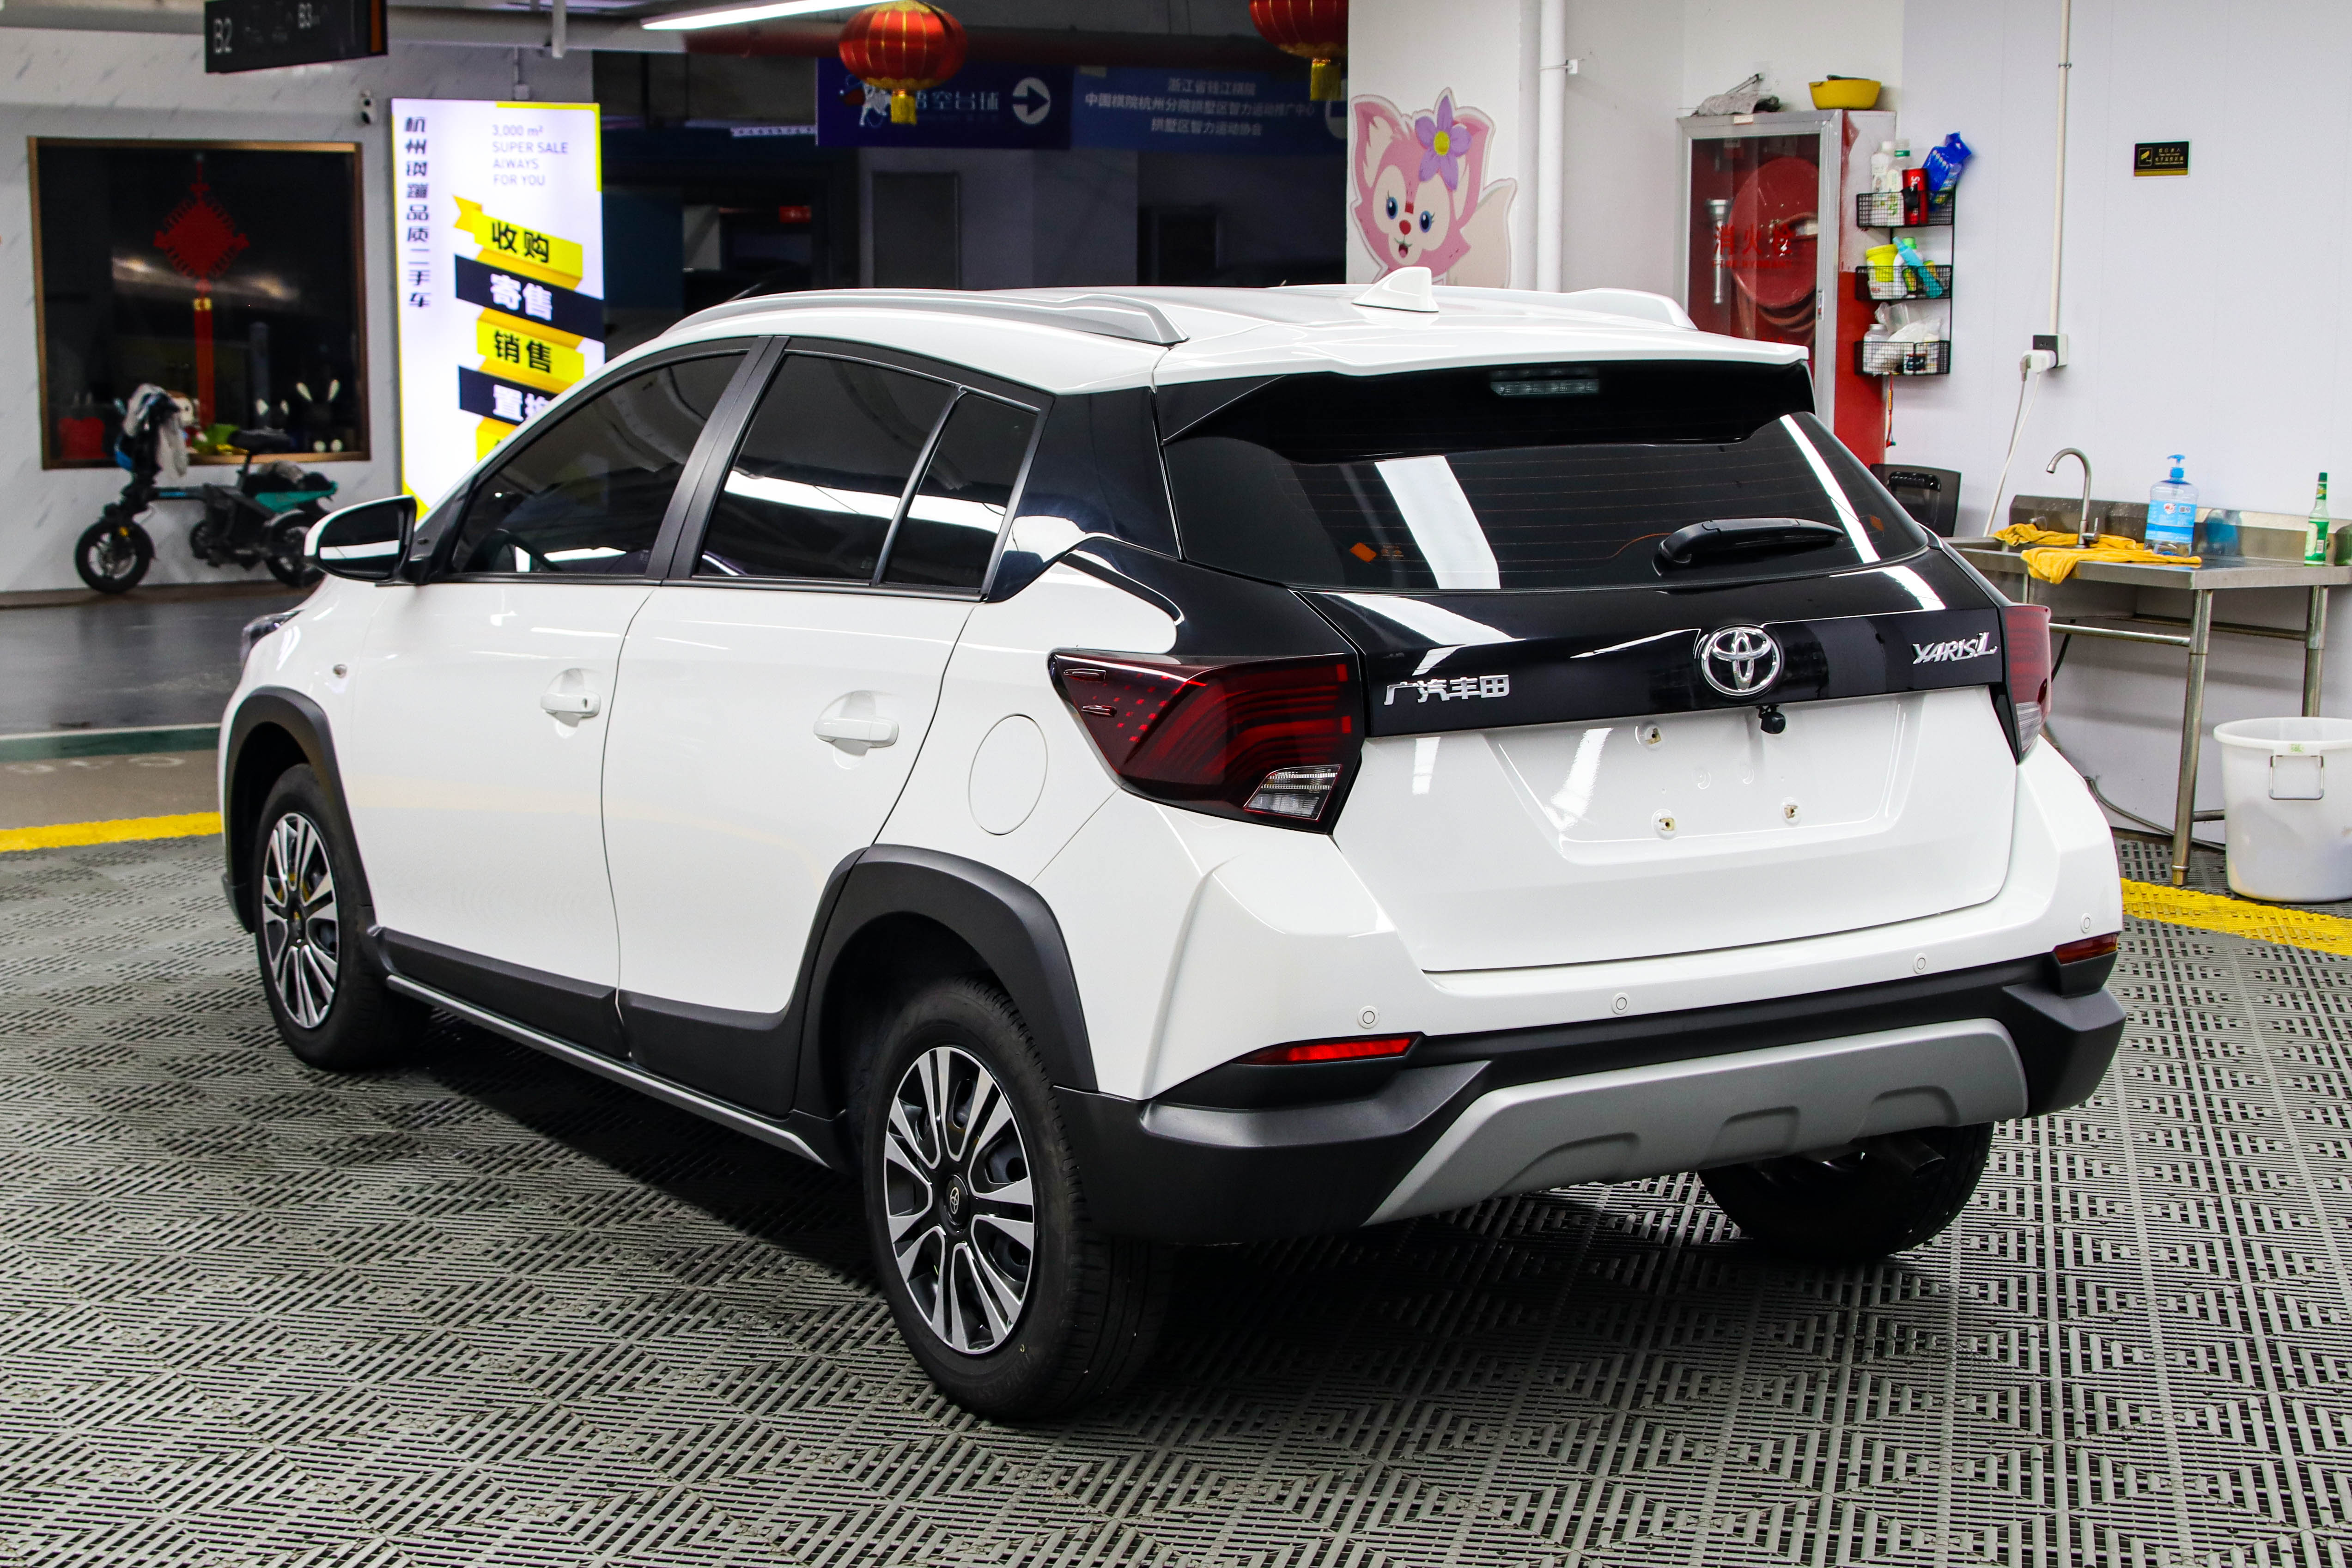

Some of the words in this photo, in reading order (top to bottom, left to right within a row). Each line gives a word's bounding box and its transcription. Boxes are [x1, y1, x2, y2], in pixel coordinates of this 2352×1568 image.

[213, 18, 232, 54] B2
[492, 141, 534, 153] SUPER
[537, 142, 569, 154] SALE
[493, 158, 539, 170] ALWAYS
[493, 174, 517, 185] FOR
[521, 174, 546, 186] YOU
[491, 221, 550, 263] 收购
[491, 274, 553, 321] 寄售
[494, 330, 552, 373] 销售
[1384, 674, 1510, 705] 广汽丰田
